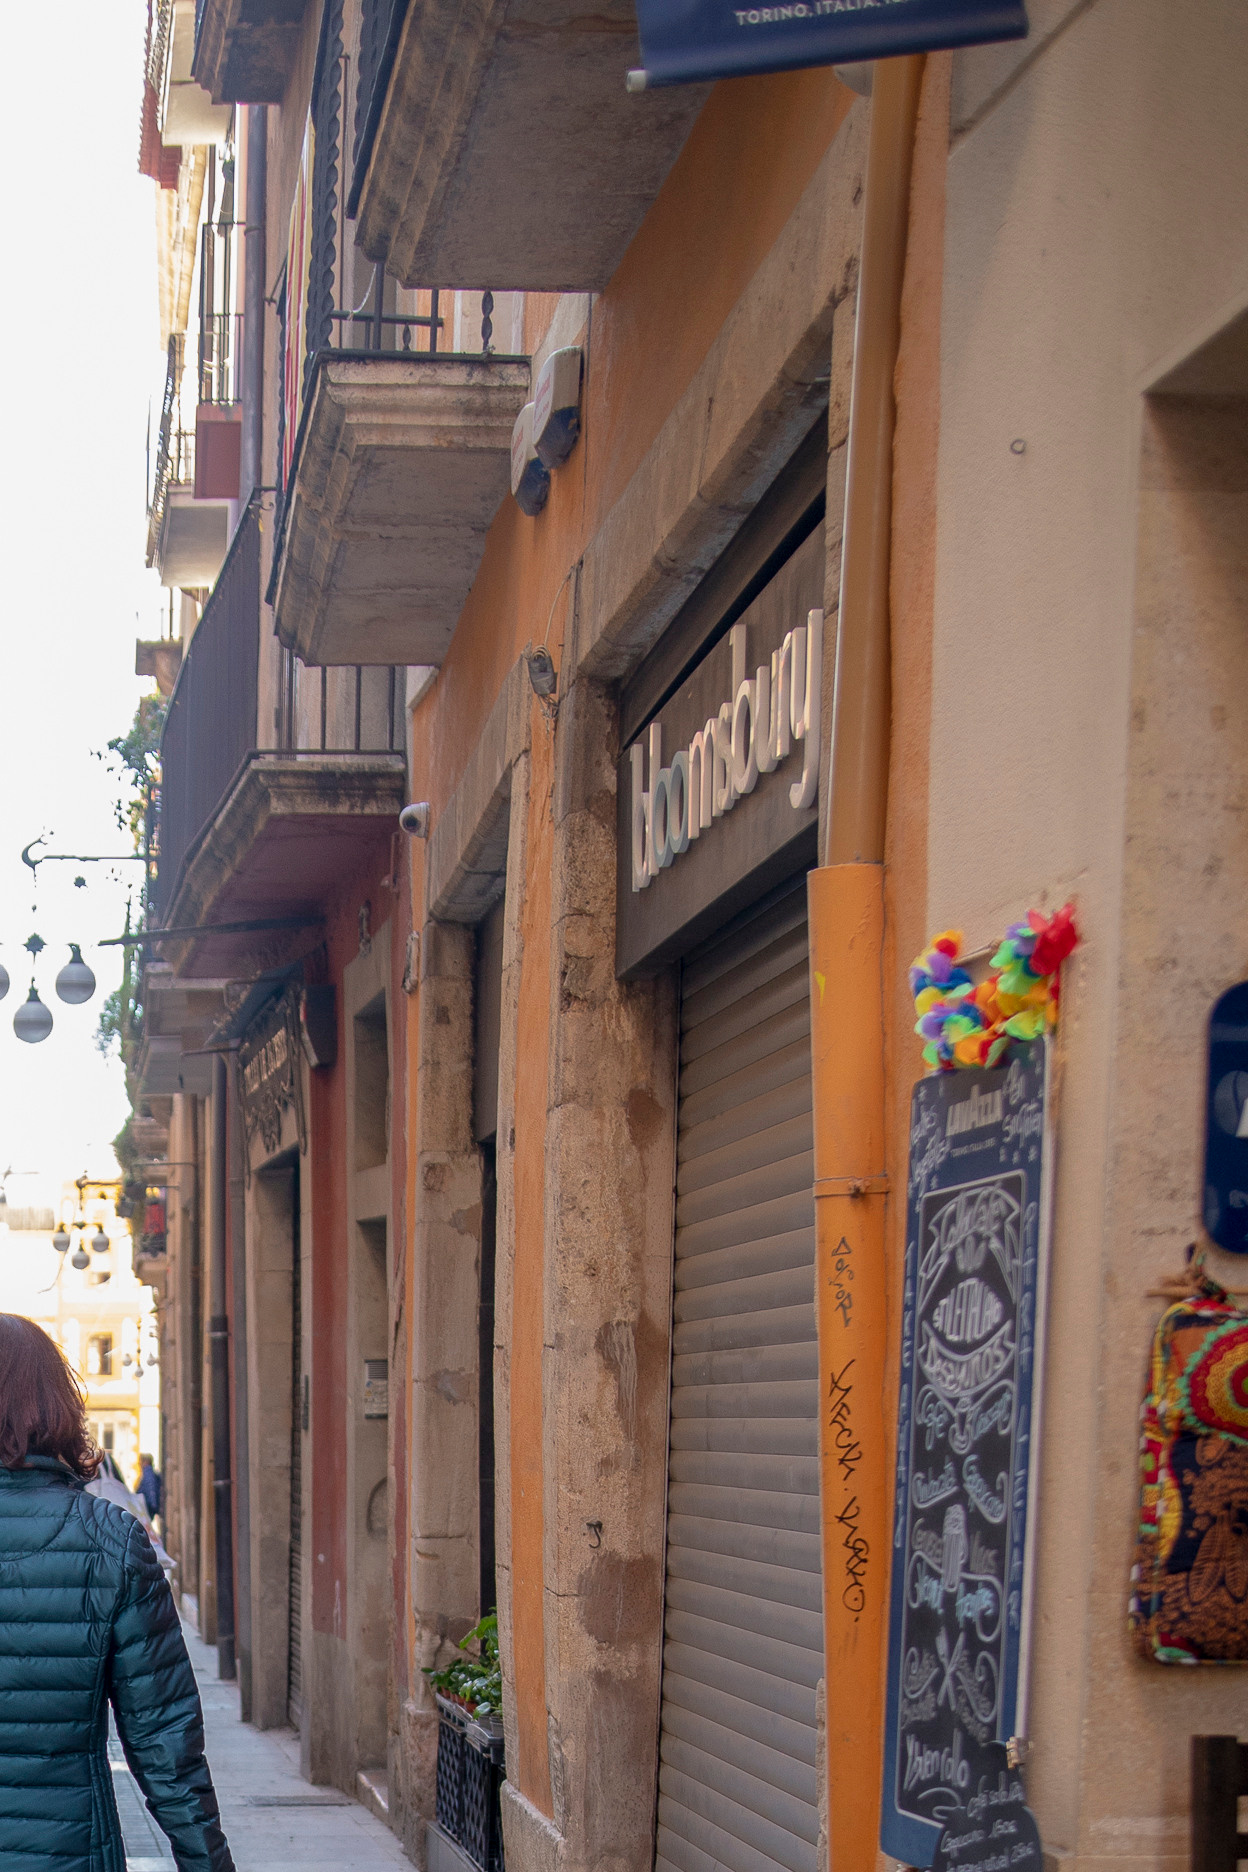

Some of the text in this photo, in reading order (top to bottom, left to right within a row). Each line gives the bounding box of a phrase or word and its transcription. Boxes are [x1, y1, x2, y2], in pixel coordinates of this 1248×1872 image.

[734, 3, 814, 26] TORINO,
[629, 608, 825, 893] bloomsbury
[946, 1084, 1003, 1137] LAVAZZA
